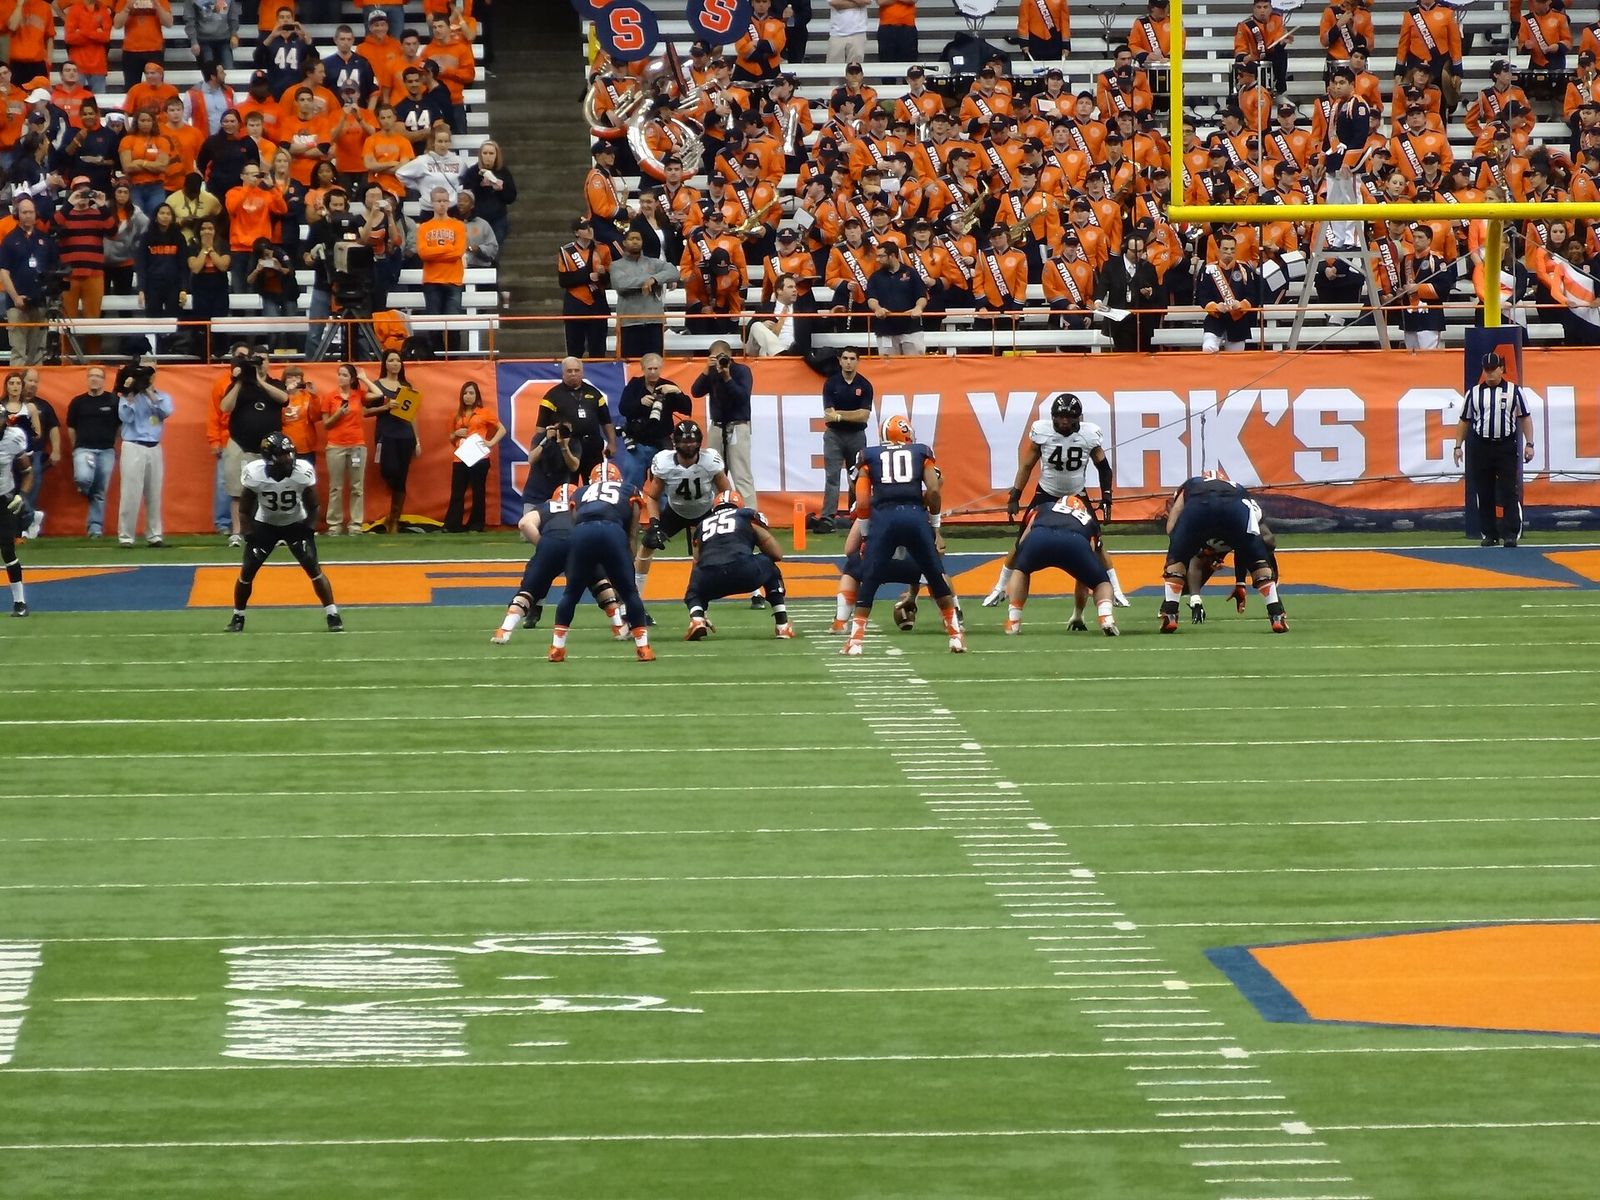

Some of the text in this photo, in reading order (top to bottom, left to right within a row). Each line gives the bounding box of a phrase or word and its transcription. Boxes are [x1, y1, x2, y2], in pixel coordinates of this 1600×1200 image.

[609, 8, 645, 51] S
[699, 0, 738, 34] S
[1413, 13, 1436, 49] SYRACUSE
[274, 47, 297, 70] 44
[405, 109, 430, 130] 44
[1402, 141, 1421, 175] SYRACUS
[986, 255, 1009, 296] SYRACUSE
[1380, 244, 1397, 285] SYRACUSE
[1057, 263, 1081, 303] SYRACUSE
[402, 399, 412, 412] S
[966, 388, 1366, 490] YORK'S
[880, 450, 912, 483] 10
[1048, 446, 1082, 471] 48
[261, 490, 297, 511] 39
[582, 482, 621, 504] 45
[676, 478, 701, 500] 41
[702, 510, 737, 541] 55
